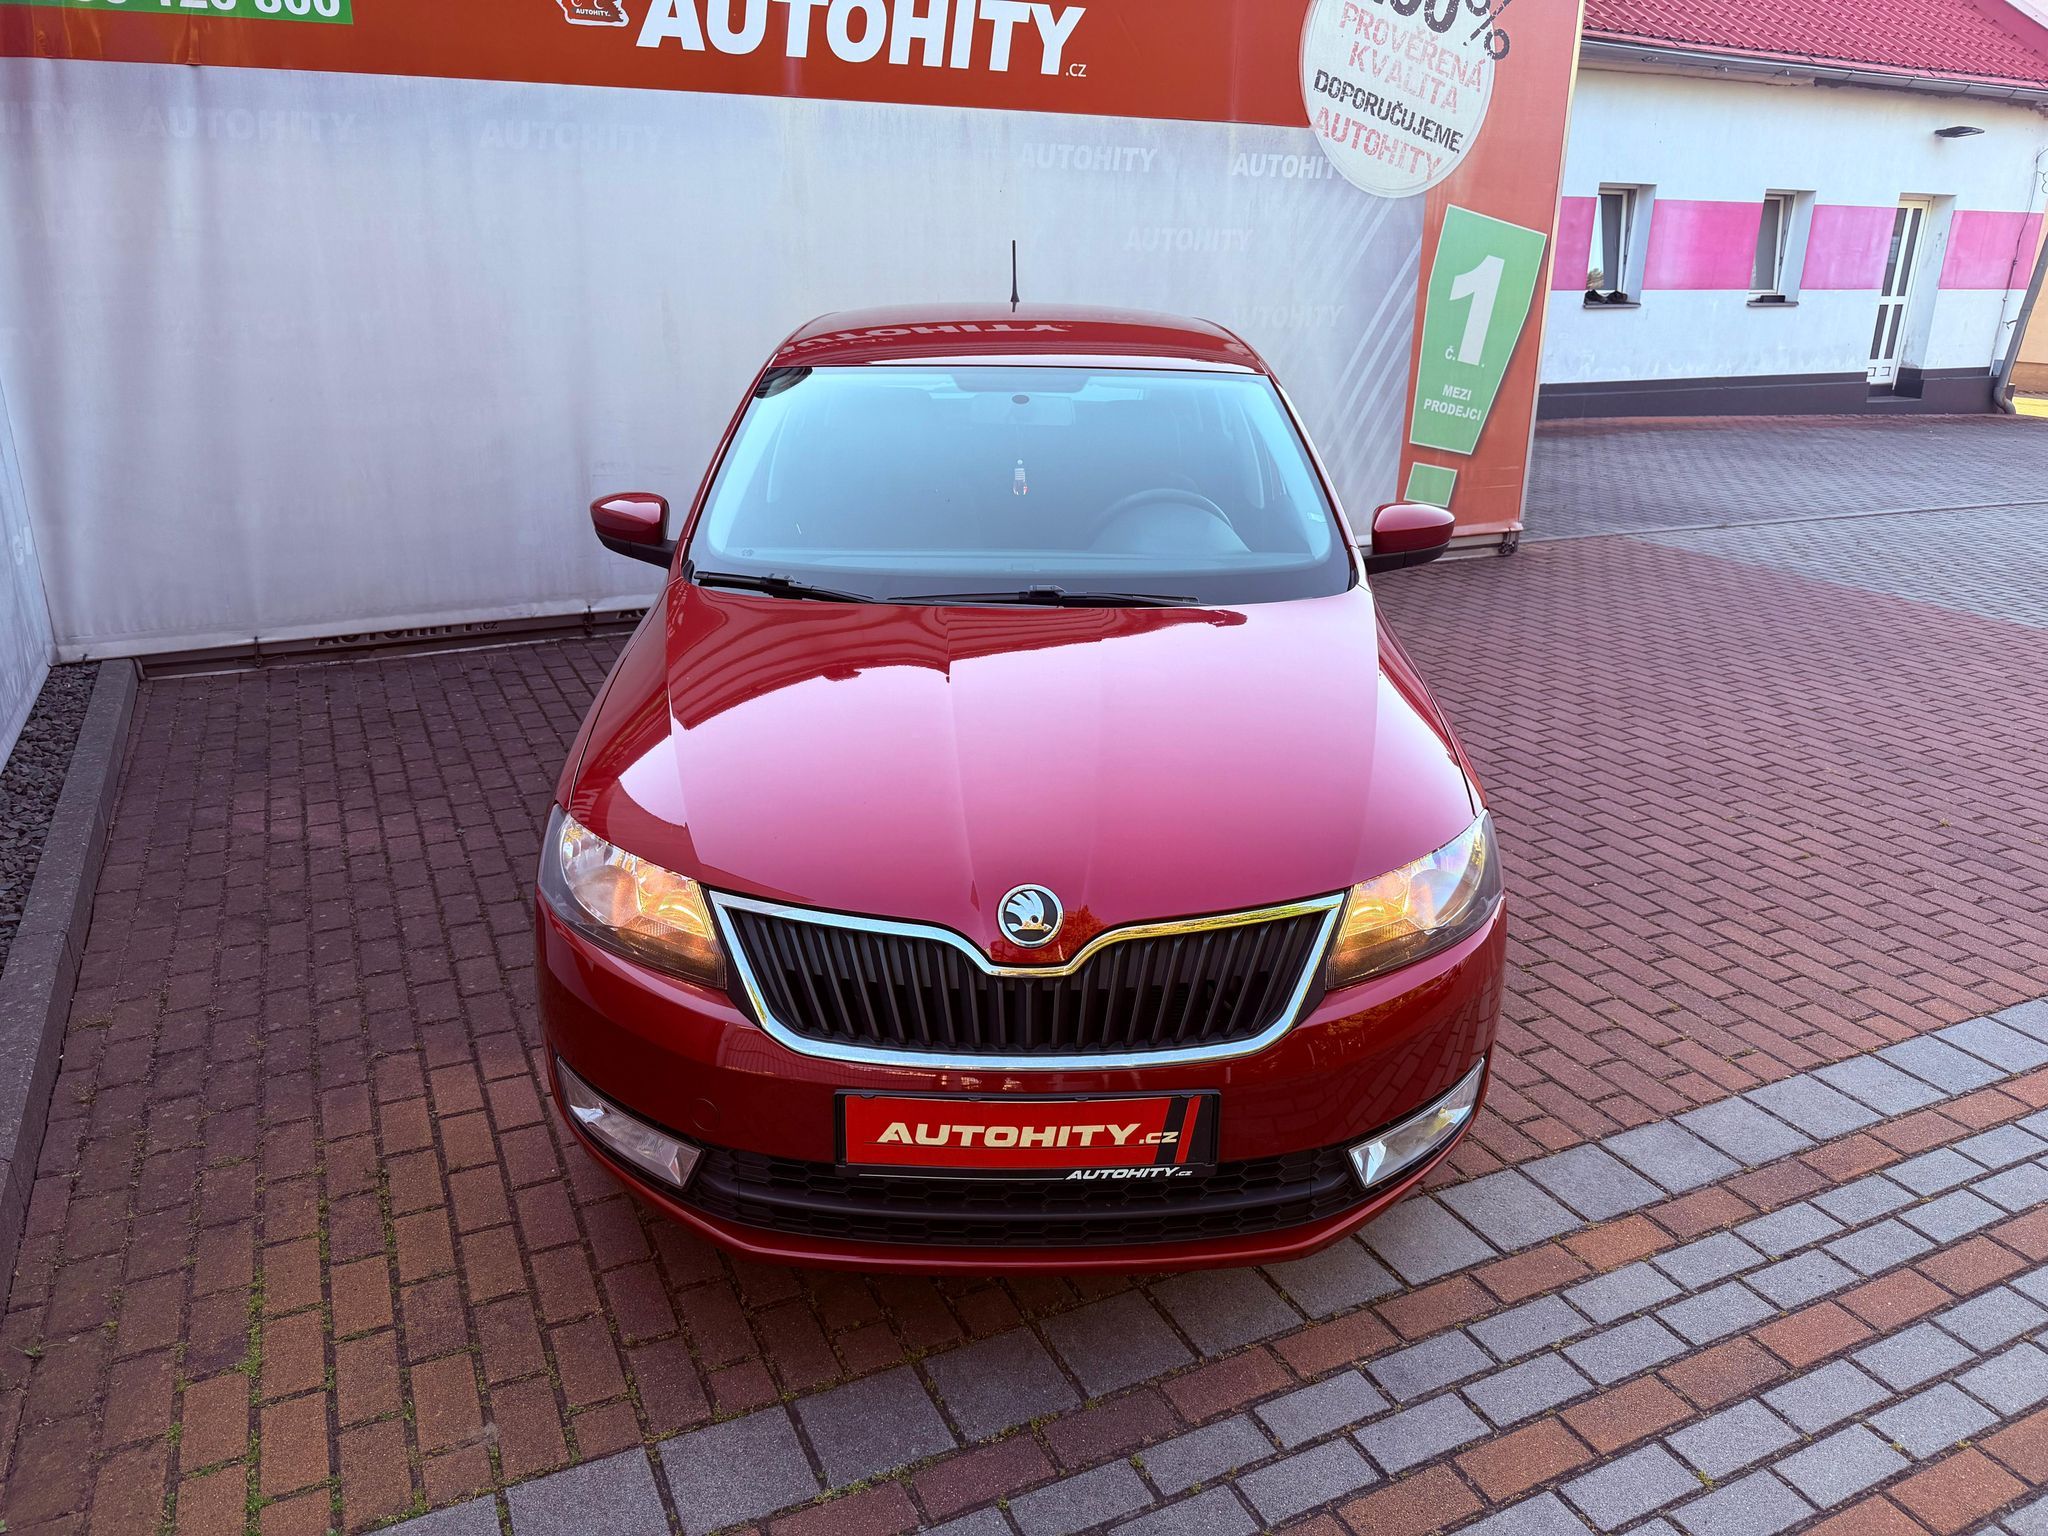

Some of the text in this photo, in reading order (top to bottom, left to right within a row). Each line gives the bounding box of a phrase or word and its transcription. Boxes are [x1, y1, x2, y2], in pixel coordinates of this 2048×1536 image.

[1348, 41, 1457, 114] KVALITA
[1313, 69, 1463, 153] DOPORUČUJEME
[1019, 143, 1159, 173] AUTOHITY
[1313, 106, 1442, 182] AUTOHITY
[1231, 153, 1340, 180] AUTOHIT
[1442, 384, 1472, 402] MEZI
[1423, 398, 1482, 422] PRODEJCI
